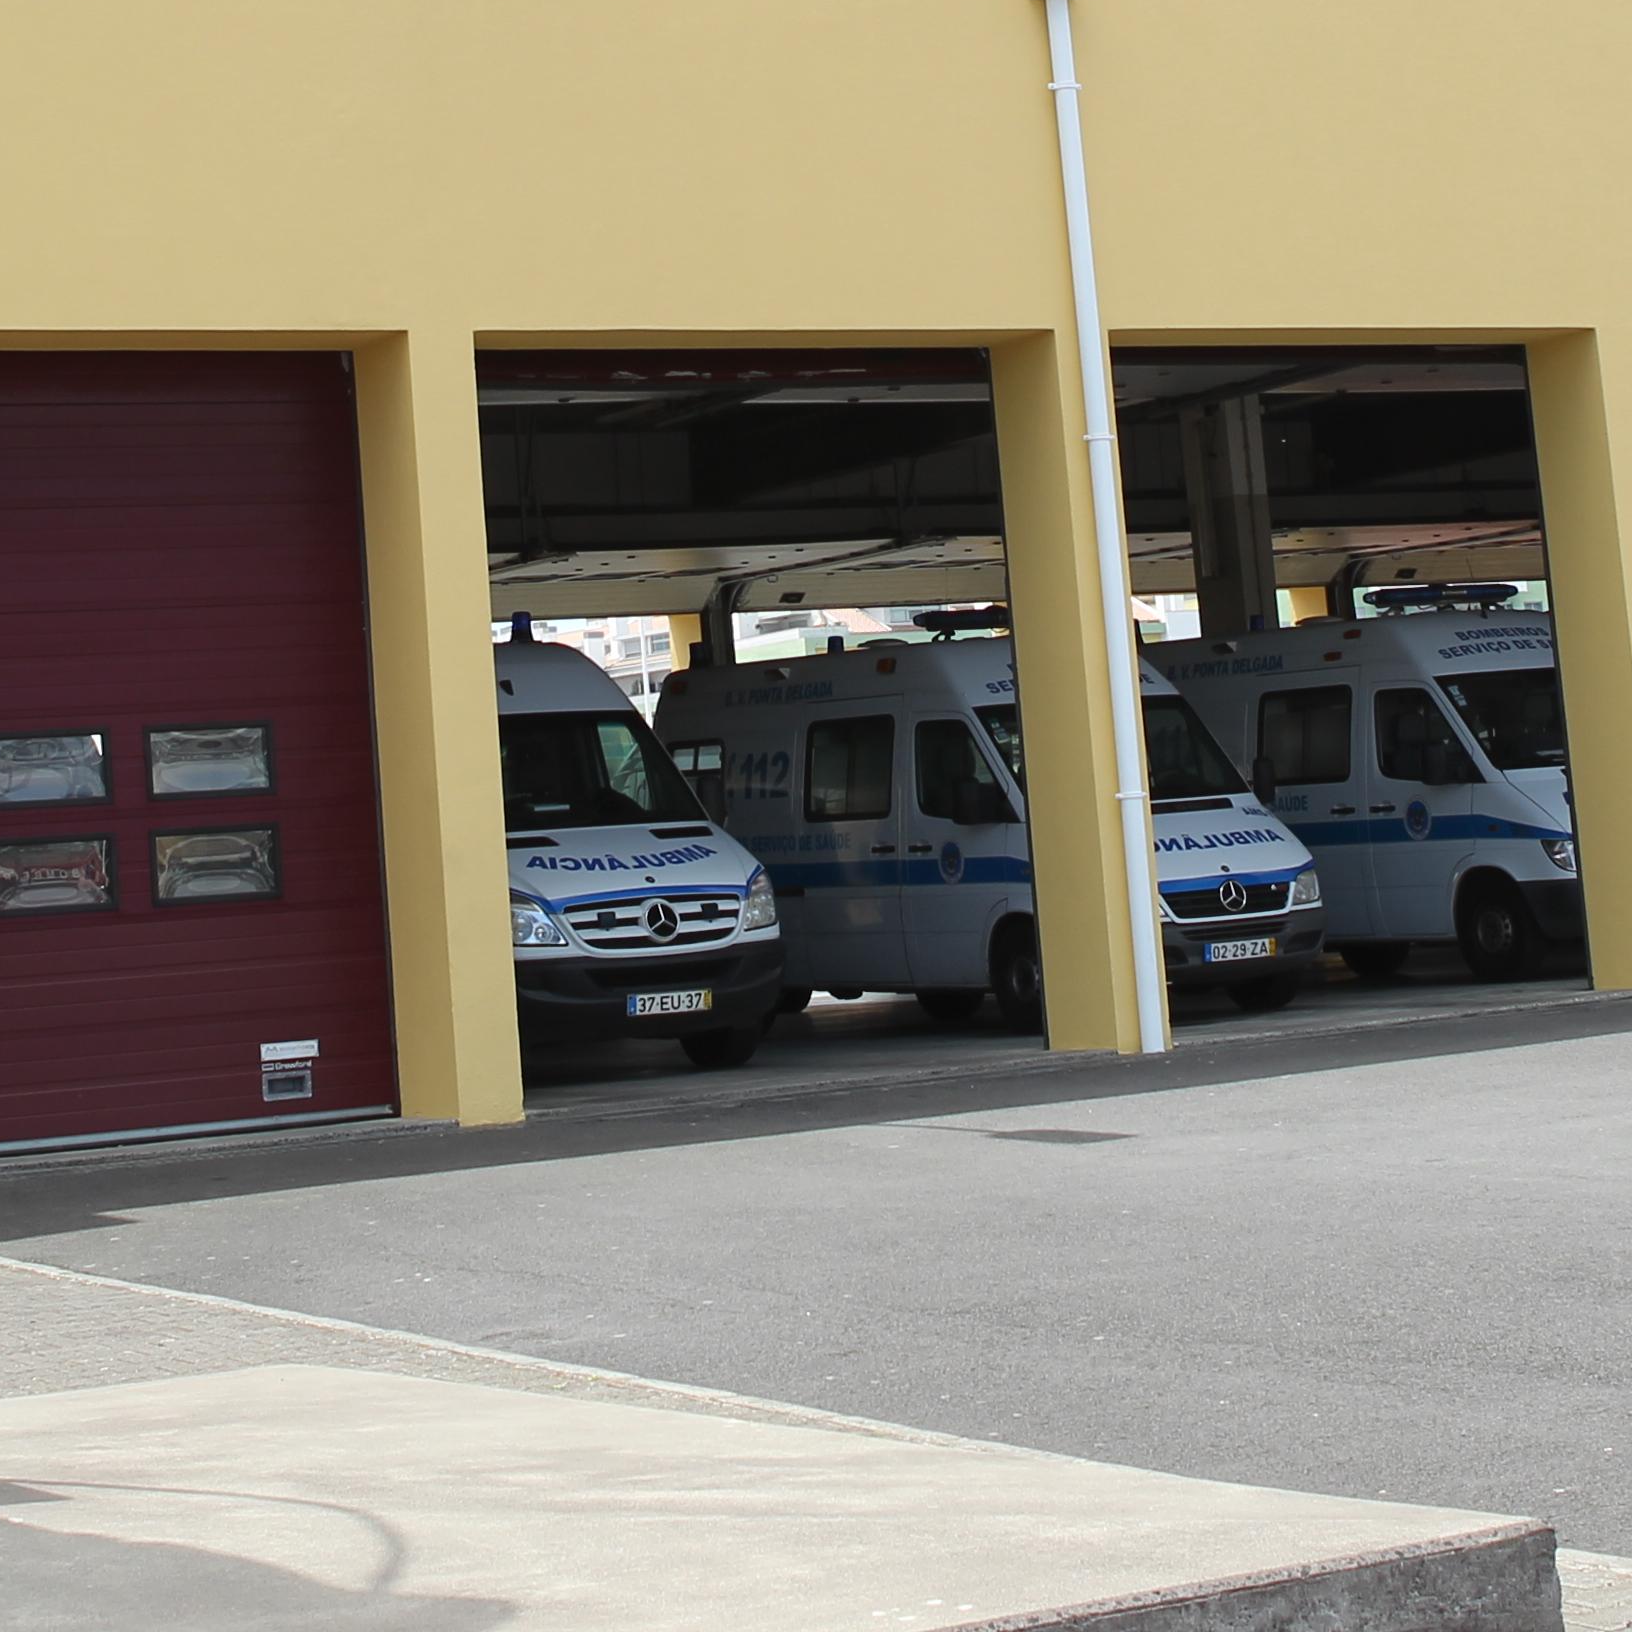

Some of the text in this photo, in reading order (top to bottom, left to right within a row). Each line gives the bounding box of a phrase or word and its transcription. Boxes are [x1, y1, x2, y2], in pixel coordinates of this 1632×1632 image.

[1455, 626, 1549, 641] BOMBEIROS
[1438, 641, 1511, 660] SERVIÇO
[1512, 639, 1538, 650] DE
[1192, 660, 1229, 679] PONTA
[1232, 654, 1283, 674] DELGADA
[748, 687, 784, 705] PONTA
[785, 680, 833, 702] DELGADA
[799, 833, 813, 851] DE
[815, 830, 852, 850] SAÚDE
